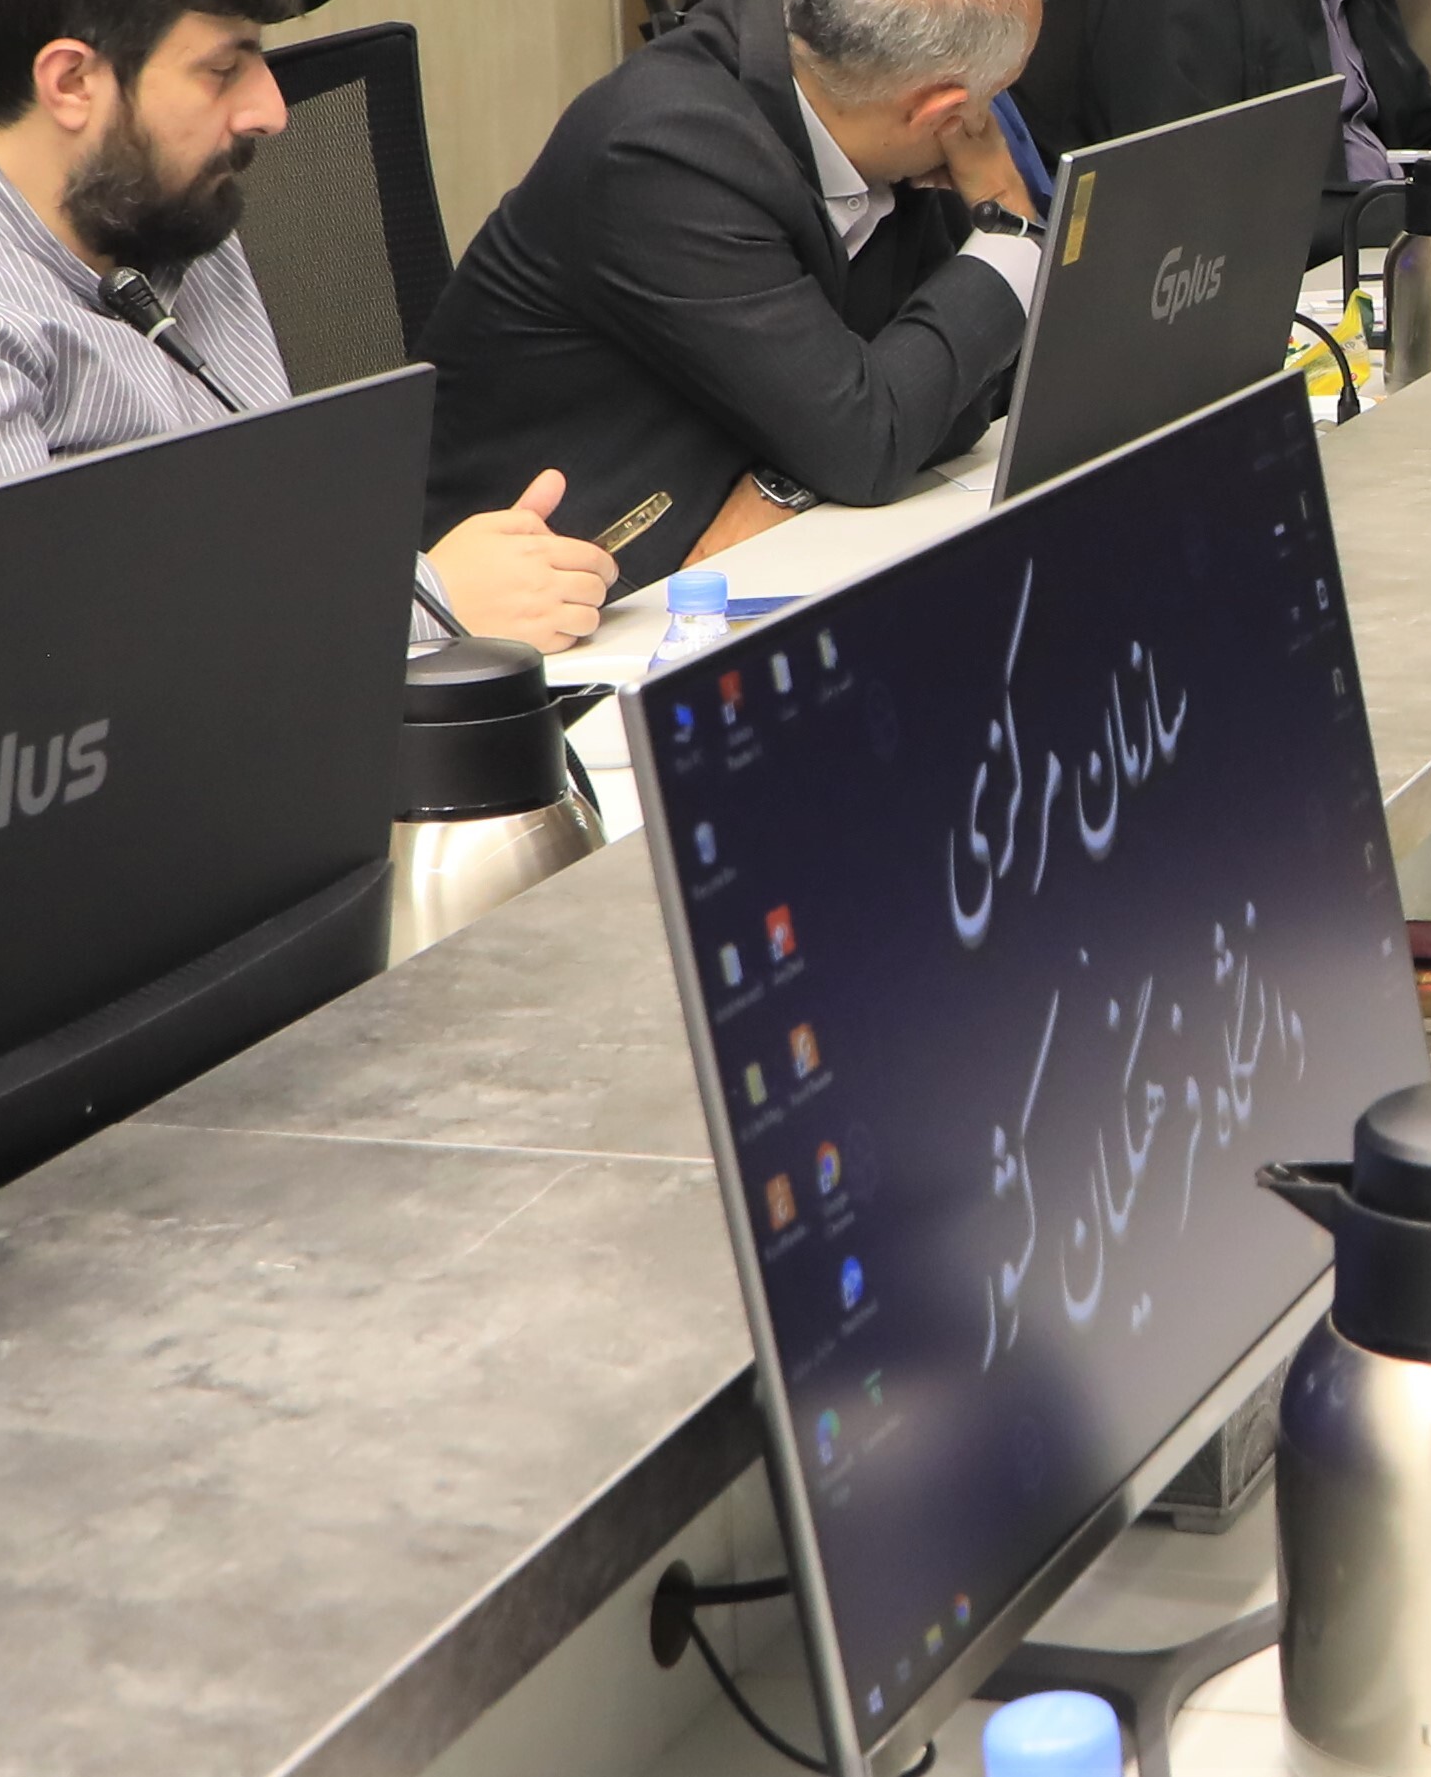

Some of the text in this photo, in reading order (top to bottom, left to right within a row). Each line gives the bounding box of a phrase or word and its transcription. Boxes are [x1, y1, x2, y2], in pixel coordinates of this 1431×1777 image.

[1151, 246, 1226, 325] Gplus
[949, 557, 1188, 948] سازمان مرکزی
